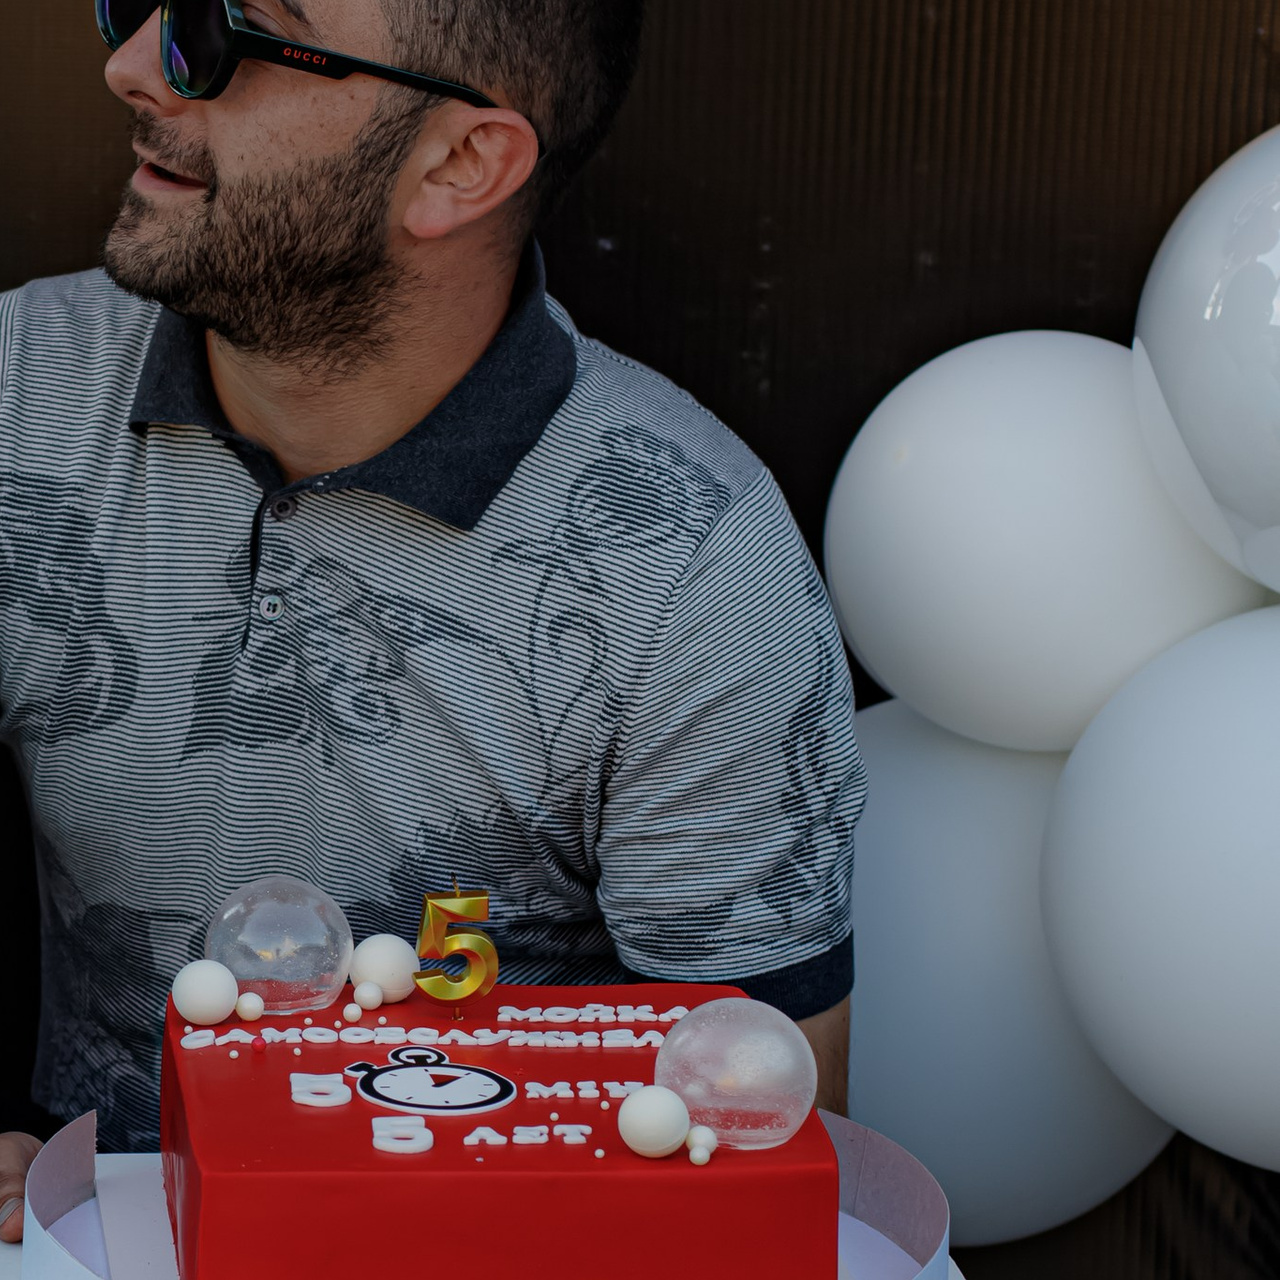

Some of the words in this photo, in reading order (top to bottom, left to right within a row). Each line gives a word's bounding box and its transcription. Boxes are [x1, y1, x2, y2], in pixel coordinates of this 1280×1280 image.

[283, 47, 327, 66] GUCCI
[411, 890, 499, 1007] 5
[180, 1026, 670, 1050] САМООБСЛУЖИВА
[289, 1072, 352, 1108] 5
[371, 1115, 434, 1154] 5
[463, 1124, 592, 1145] ЛЕТ
